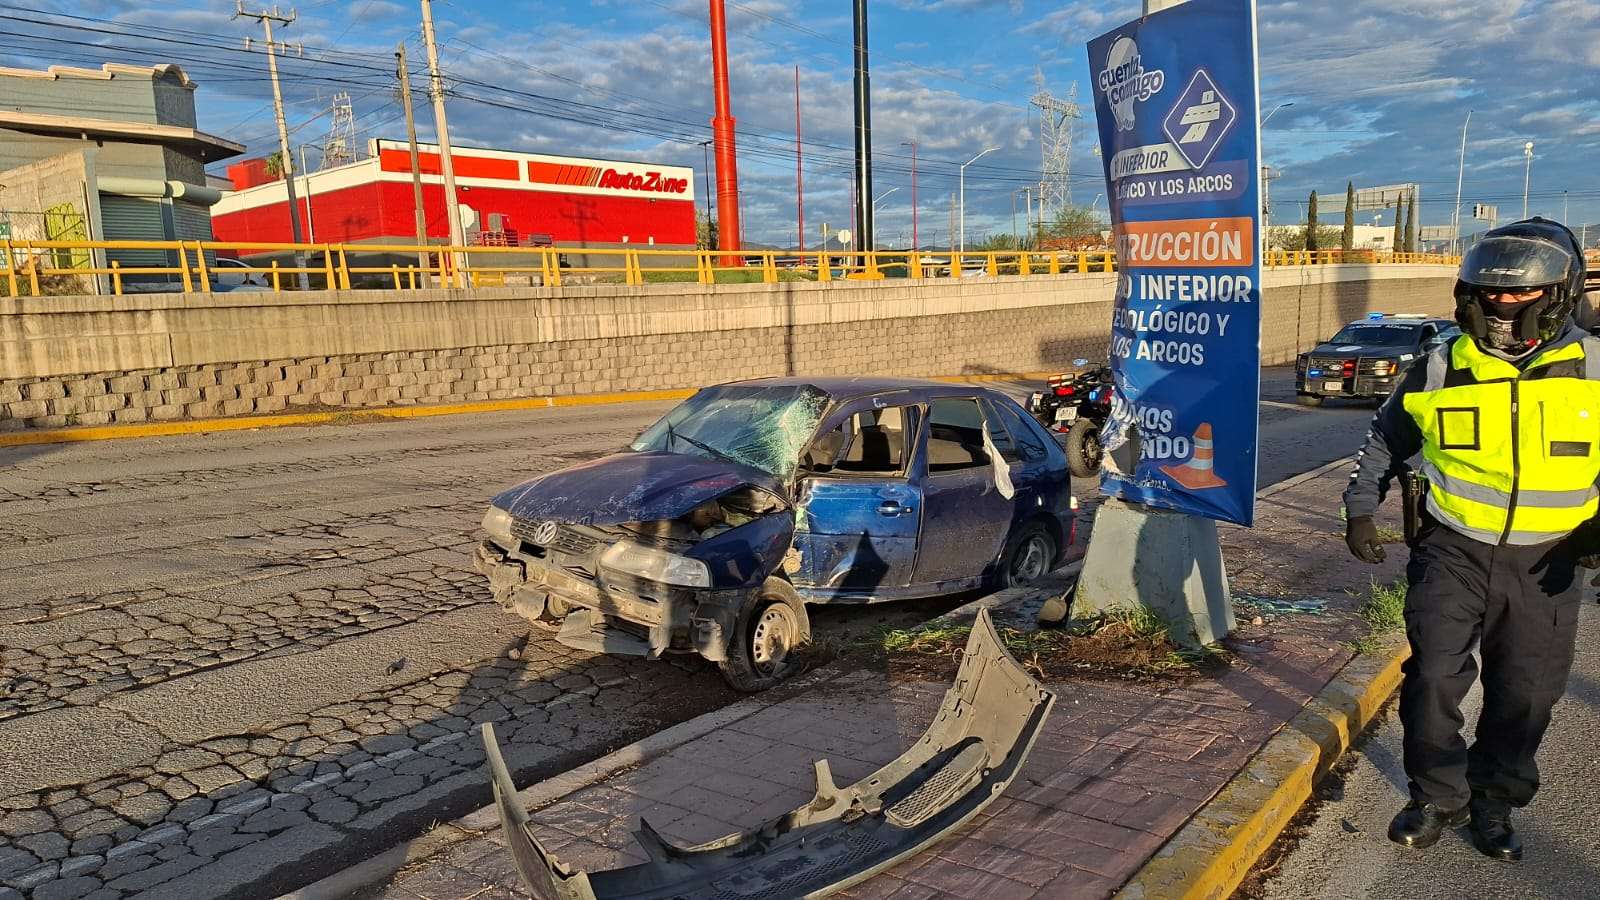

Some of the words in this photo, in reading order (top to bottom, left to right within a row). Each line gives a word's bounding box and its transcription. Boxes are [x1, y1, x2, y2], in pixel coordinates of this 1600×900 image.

[598, 168, 688, 193] AutoZone
[1148, 181, 1158, 196] Y
[1160, 178, 1185, 196] LOS
[1187, 173, 1233, 193] ARCOS
[1140, 274, 1252, 303] INFERIOR
[1216, 313, 1231, 337] Y
[1135, 340, 1204, 366] ARCOS
